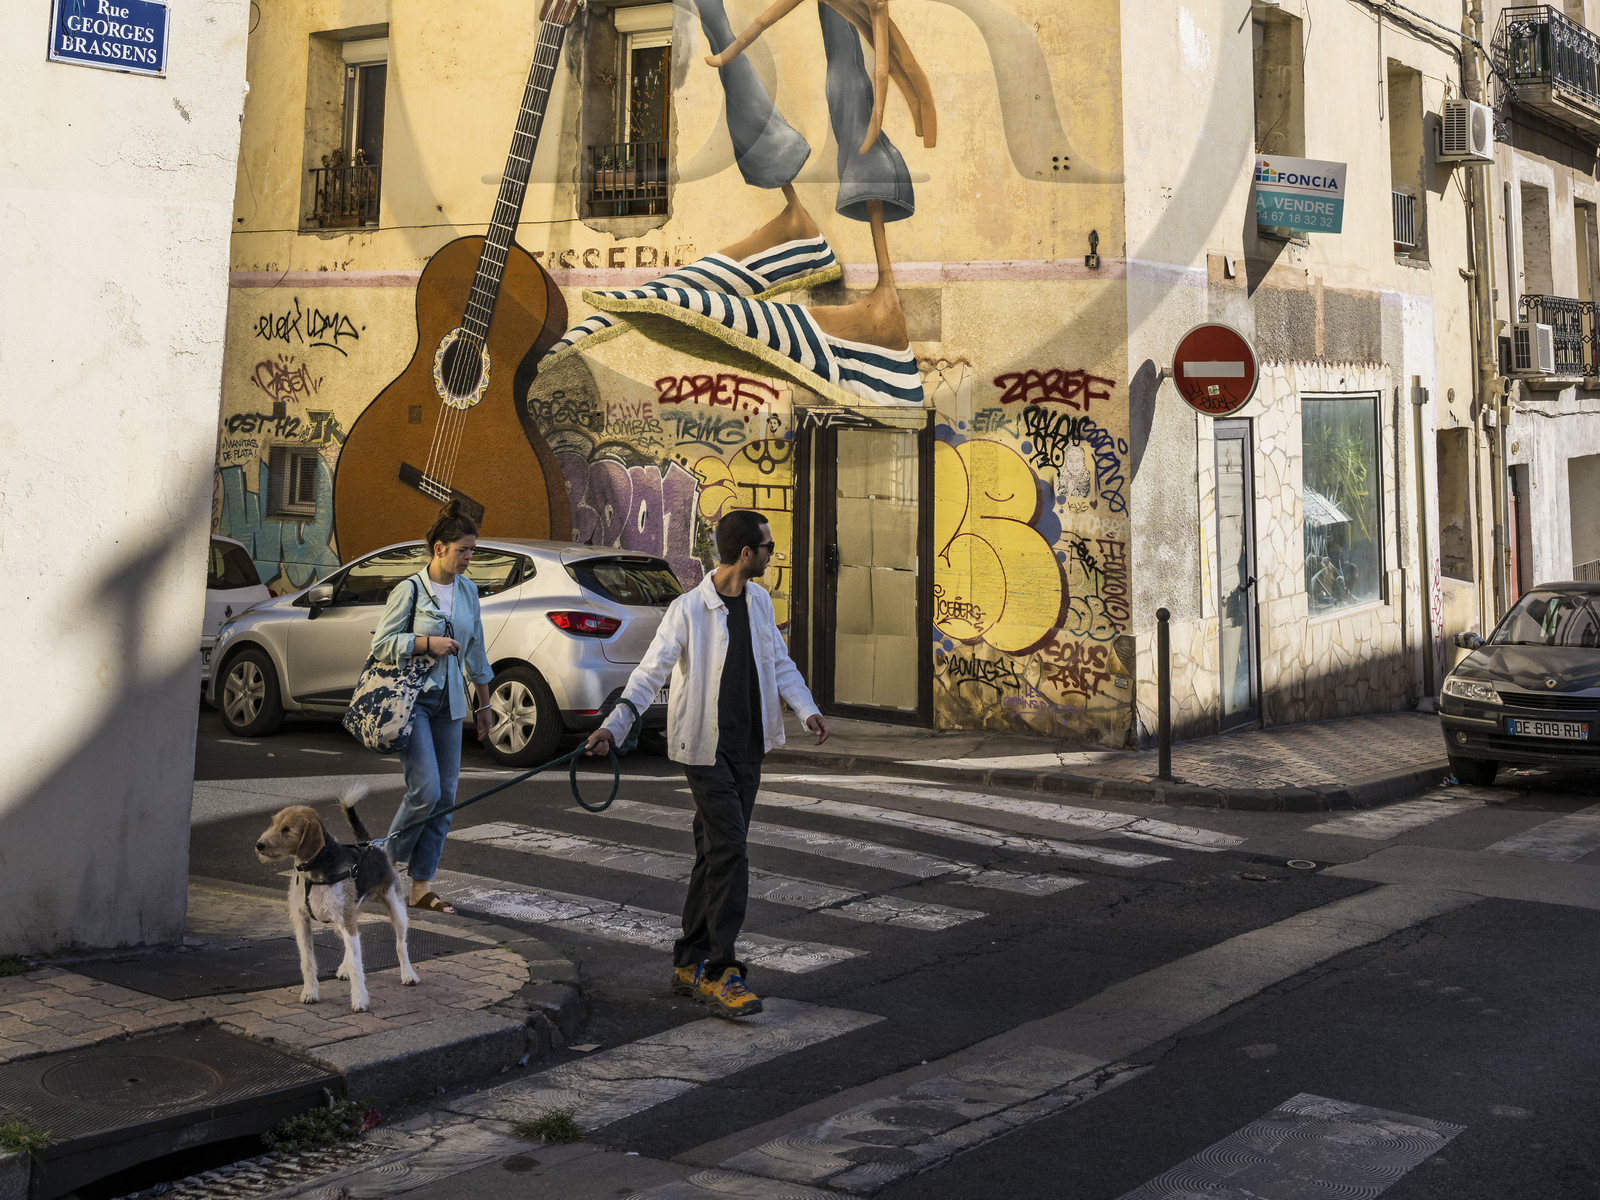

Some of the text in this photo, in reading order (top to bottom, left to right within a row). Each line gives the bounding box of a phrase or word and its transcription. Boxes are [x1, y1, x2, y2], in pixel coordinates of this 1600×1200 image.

[67, 15, 154, 43] GEORGES
[61, 34, 157, 64] BRASSENS
[1278, 172, 1338, 190] FONCIA
[1256, 192, 1335, 216] À VENDRE
[1271, 211, 1285, 222] 67
[1289, 213, 1301, 224] 18
[1304, 215, 1317, 226] 32
[1320, 217, 1333, 228] 32
